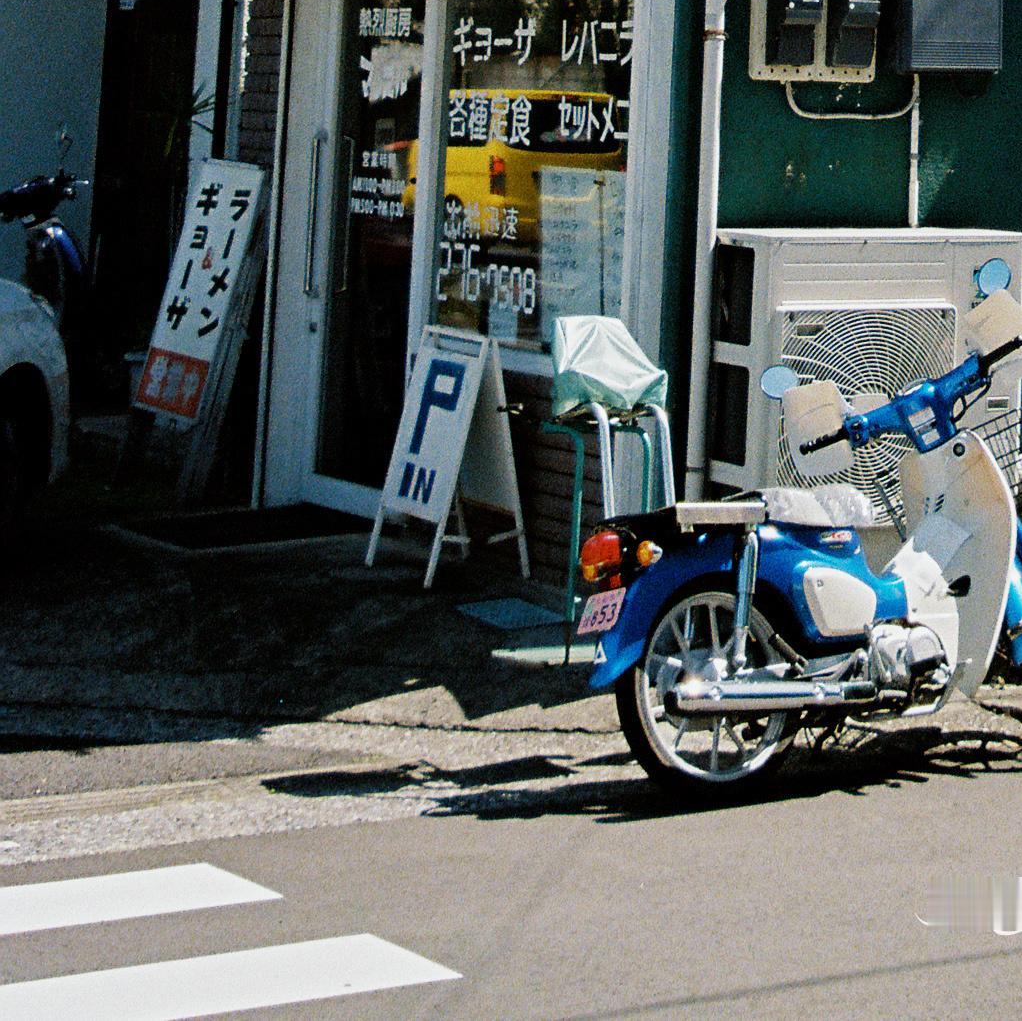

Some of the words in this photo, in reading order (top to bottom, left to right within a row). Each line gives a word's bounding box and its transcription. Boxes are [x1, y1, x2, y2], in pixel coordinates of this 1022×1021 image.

[453, 17, 536, 66] ギョーザ
[449, 90, 532, 146] 各種定食
[166, 182, 224, 331] ギョーザ
[198, 189, 251, 338] ラーメン
[409, 358, 466, 455] P
[398, 462, 437, 505] IN
